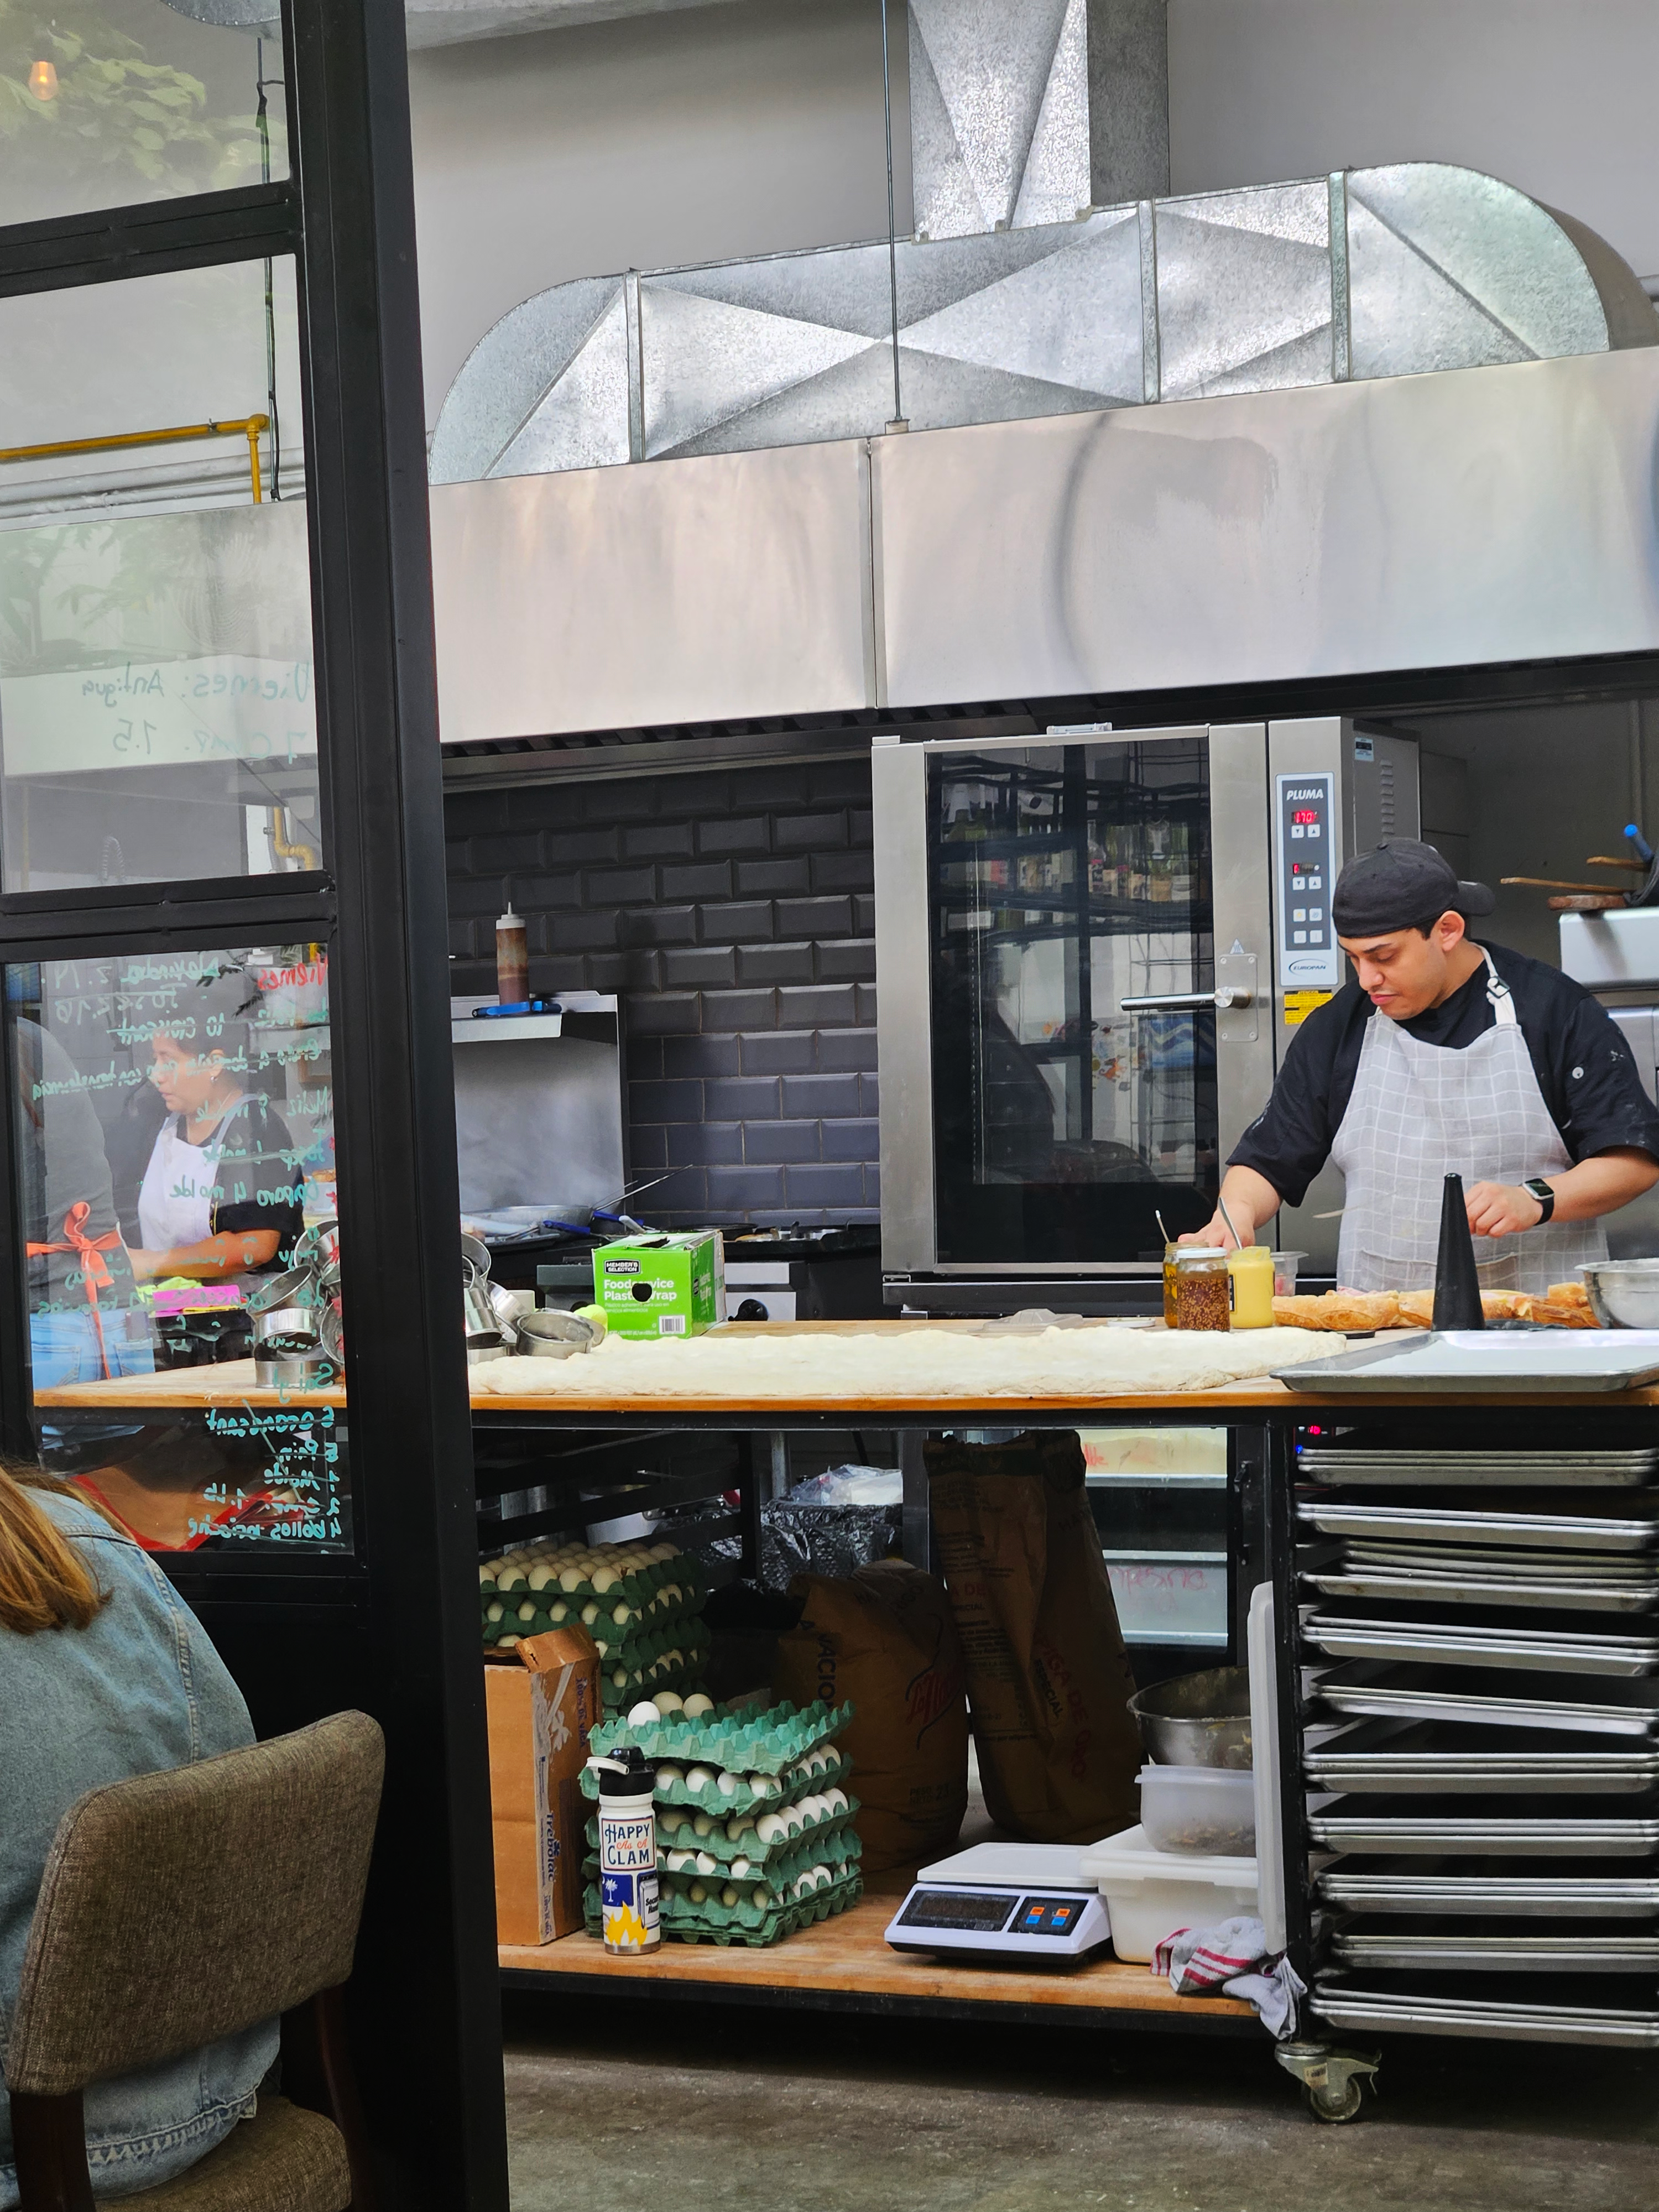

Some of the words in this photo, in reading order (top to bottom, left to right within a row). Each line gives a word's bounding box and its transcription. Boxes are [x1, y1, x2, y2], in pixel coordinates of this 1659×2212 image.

[1286, 789, 1324, 801] PLUMA
[605, 1824, 649, 1844] HAPPY
[546, 1812, 555, 1882] Trebolac
[608, 1845, 649, 1865] CLAM
